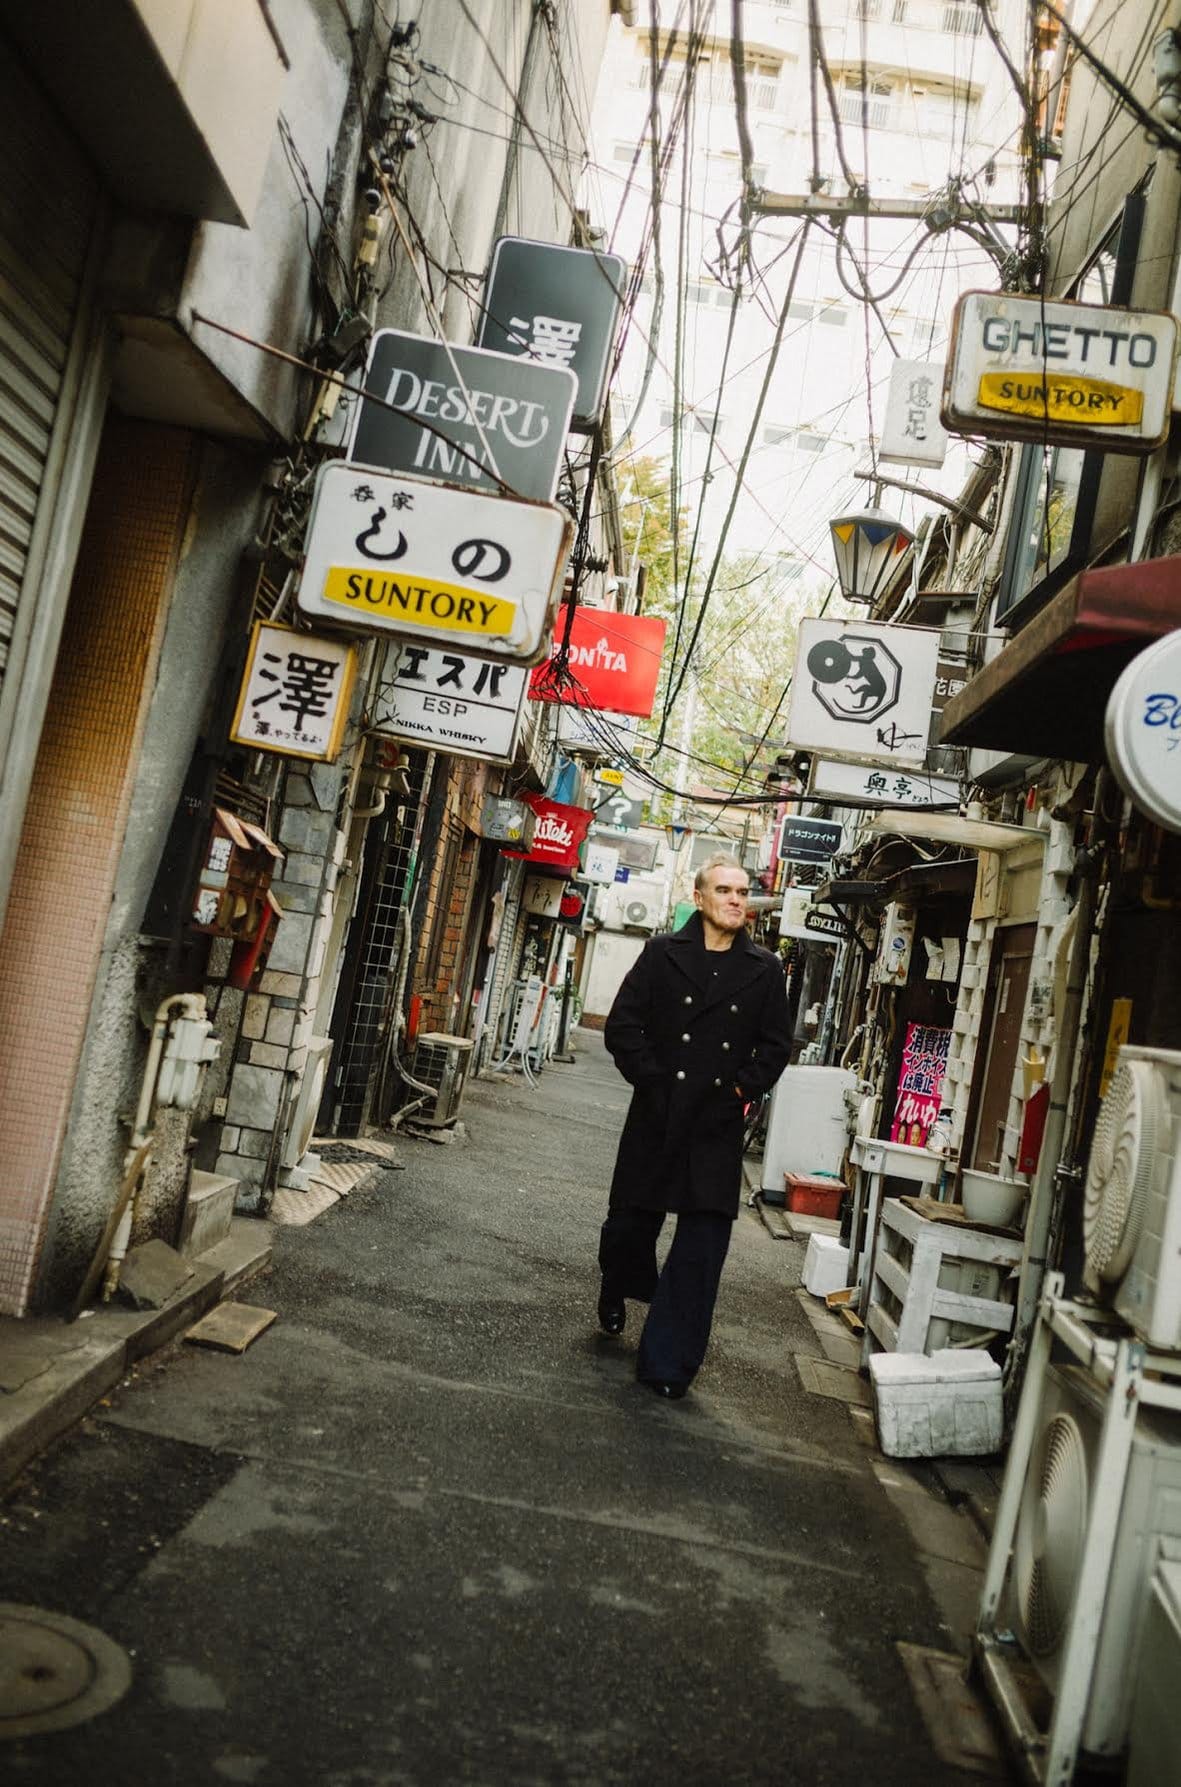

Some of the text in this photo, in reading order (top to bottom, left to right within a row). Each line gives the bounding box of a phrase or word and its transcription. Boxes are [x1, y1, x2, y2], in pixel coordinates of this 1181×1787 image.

[982, 317, 1157, 368] GHETTO
[384, 368, 549, 448] DESERT
[1000, 381, 1124, 411] SUNTORY
[413, 428, 489, 480] INN
[346, 574, 498, 626] SUNTORY
[252, 652, 340, 731] 澤
[398, 647, 509, 699] エスパ
[396, 718, 487, 745] NIKKA WHISKY
[422, 696, 468, 718] ESP
[902, 1071, 934, 1096] は廃止
[900, 1094, 937, 1128] れいわ
